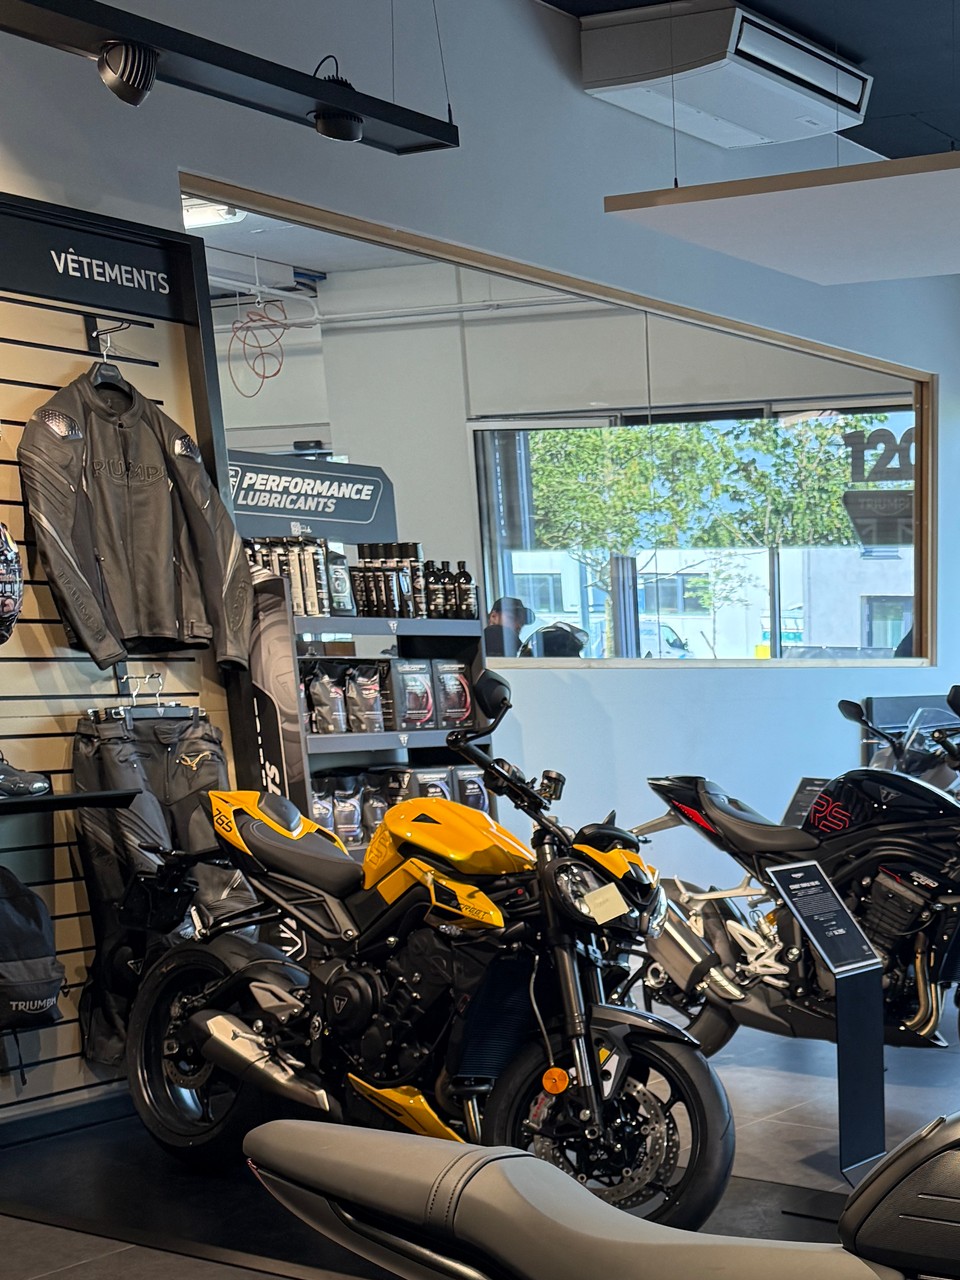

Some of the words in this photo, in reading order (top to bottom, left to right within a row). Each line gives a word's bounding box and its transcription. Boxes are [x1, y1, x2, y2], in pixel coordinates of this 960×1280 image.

[50, 247, 170, 295] VÊTEMENTS
[93, 460, 167, 482] RIUMP
[242, 472, 374, 500] PERFORMANCE
[237, 490, 337, 513] LUBRICANTS
[213, 807, 233, 833] 765
[810, 792, 852, 834] RS
[10, 996, 57, 1014] TRIUMPH
